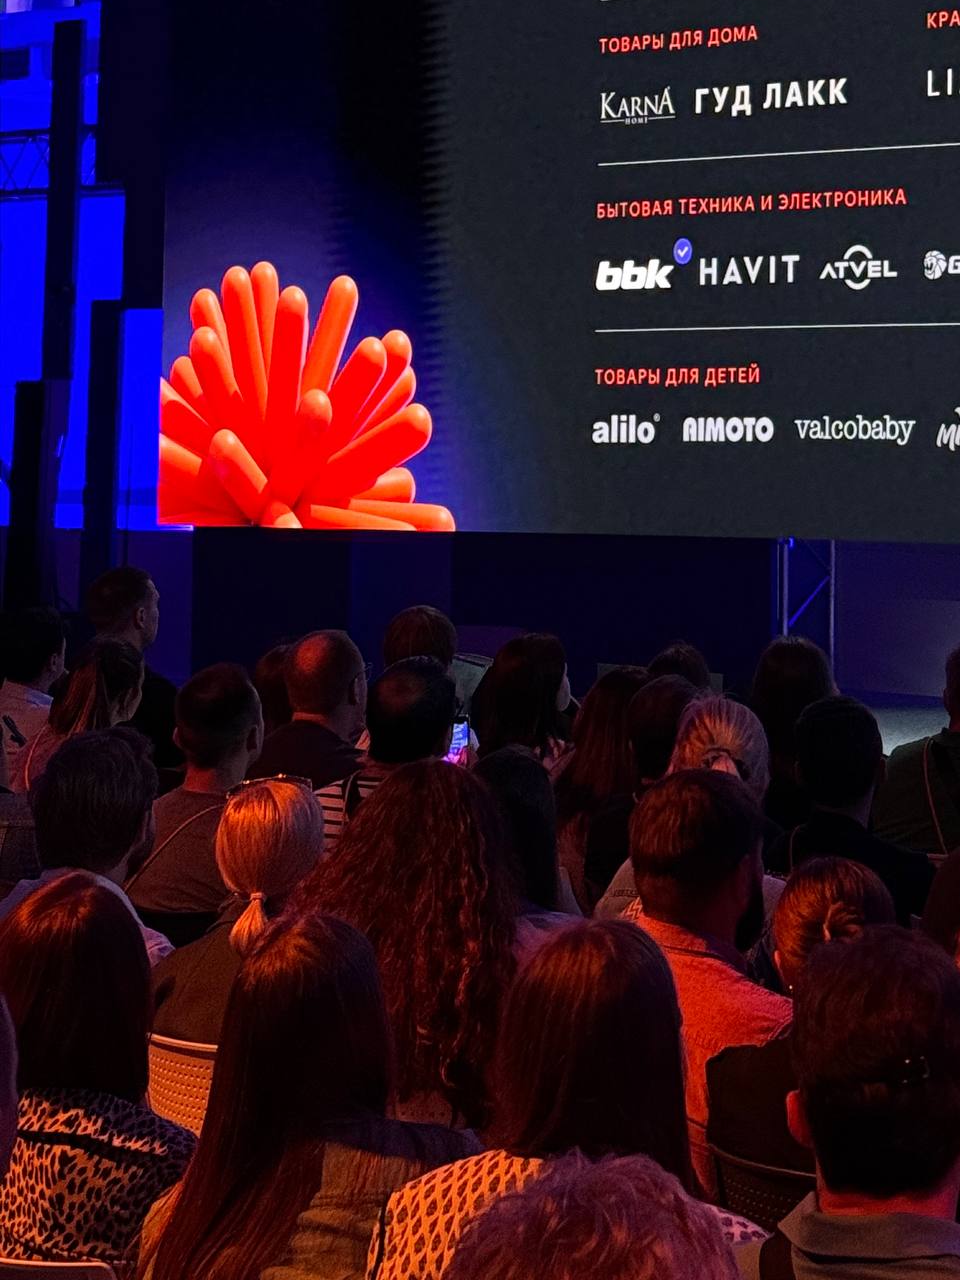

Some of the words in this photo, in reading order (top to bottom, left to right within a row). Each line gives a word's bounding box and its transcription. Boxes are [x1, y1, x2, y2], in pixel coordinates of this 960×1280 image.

[598, 33, 664, 54] ТОВАРЫ
[668, 29, 703, 51] ДЛЯ
[707, 24, 758, 47] ДОМА
[695, 84, 752, 117] ГУД
[762, 77, 848, 109] ЛАКК
[596, 199, 673, 219] БЫТОВАЯ
[678, 195, 755, 215] ТЕХНИКА
[760, 194, 773, 211] И
[778, 188, 907, 211] ЭЛЕКТРОНИКА
[594, 258, 674, 291] bbk
[699, 254, 800, 286] HAVIT
[819, 259, 898, 280] ATVEL
[594, 367, 661, 385] ТОВАРЫ
[664, 367, 700, 388] ДЛЯ
[704, 362, 760, 388] ДЕТЕЙ
[682, 416, 775, 443] AIMOTO
[793, 414, 917, 446] valcobaby
